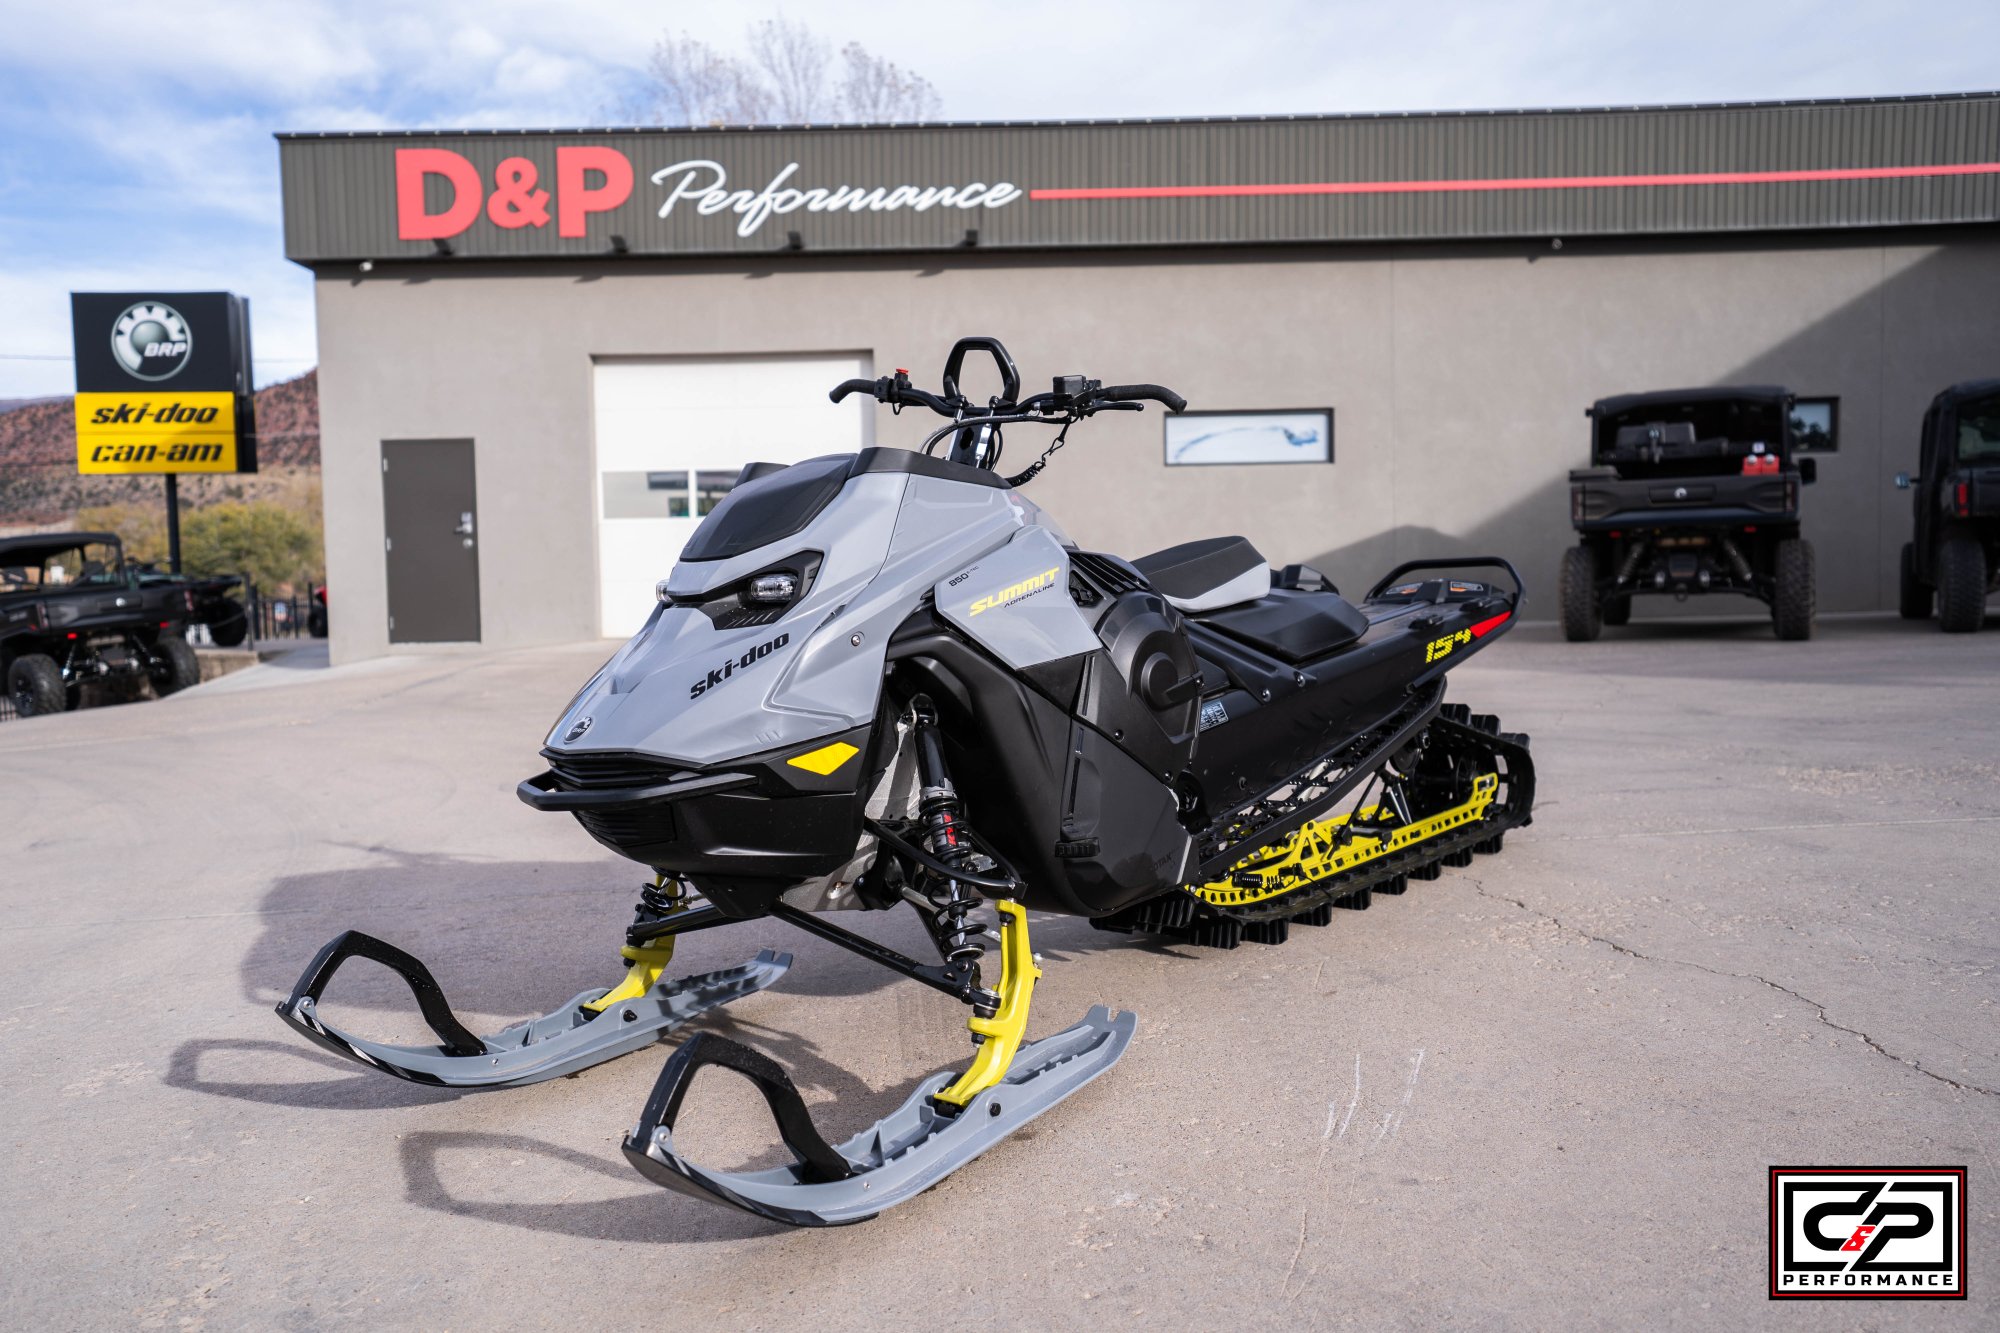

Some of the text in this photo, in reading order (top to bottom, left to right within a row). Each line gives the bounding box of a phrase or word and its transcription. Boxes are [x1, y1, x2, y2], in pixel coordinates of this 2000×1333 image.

[395, 146, 1022, 240] D&P Performance
[144, 342, 187, 357] BRP
[91, 403, 219, 424] ski-doo
[91, 443, 223, 463] can-am
[948, 572, 969, 587] 850
[969, 566, 1060, 617] SUMMIT
[1003, 582, 1055, 608] ADRENALINE
[1425, 628, 1471, 663] 154
[690, 632, 790, 700] ski-doo
